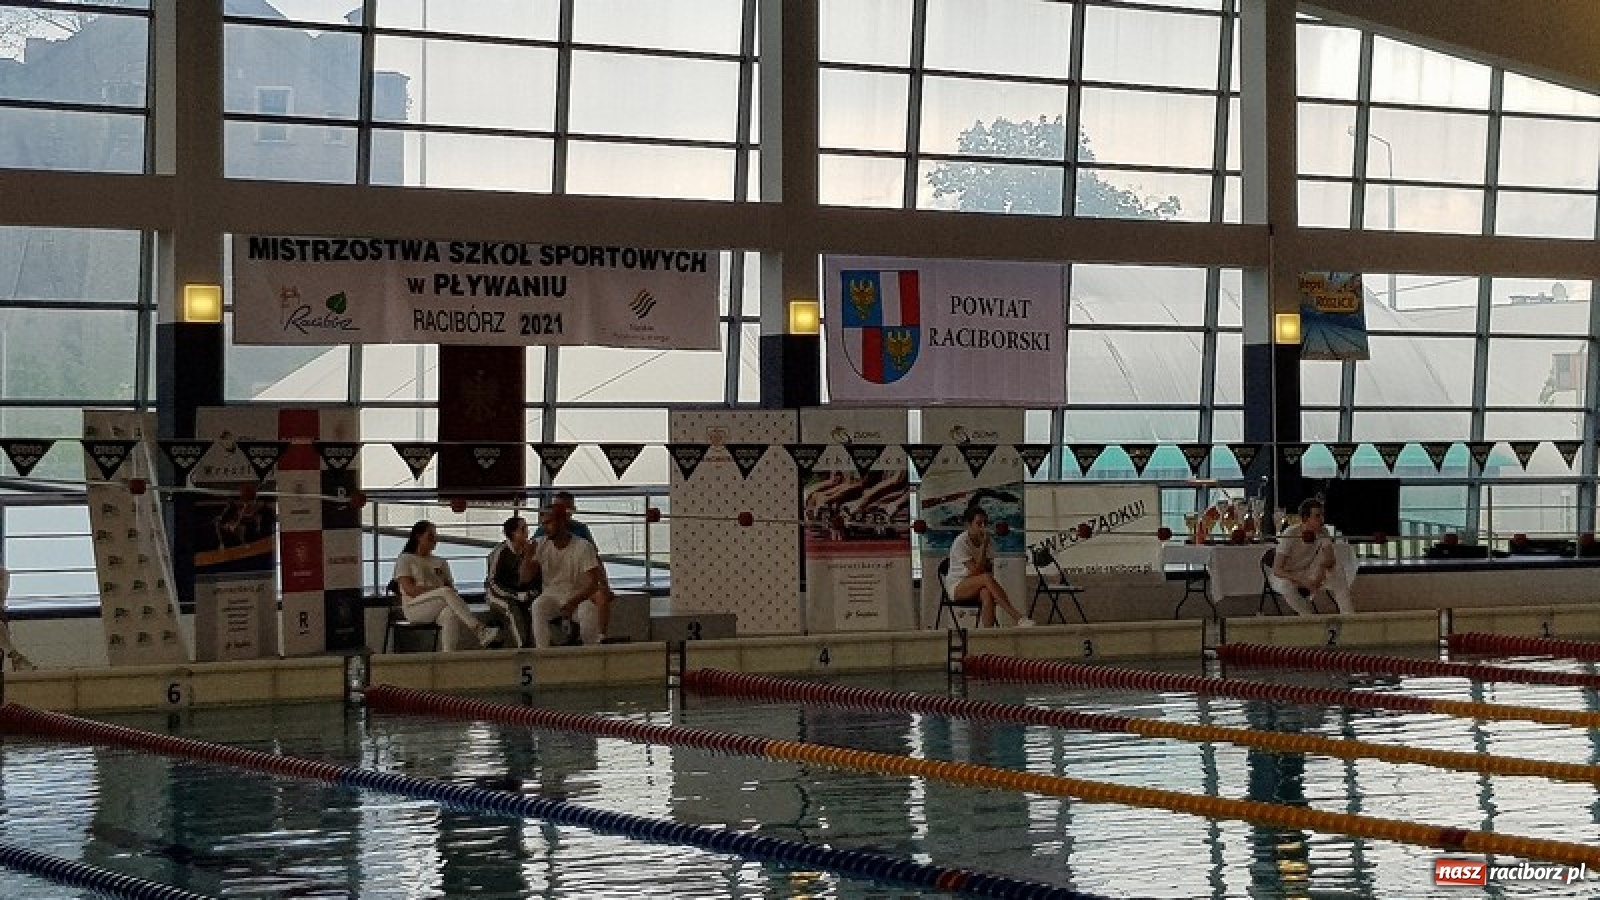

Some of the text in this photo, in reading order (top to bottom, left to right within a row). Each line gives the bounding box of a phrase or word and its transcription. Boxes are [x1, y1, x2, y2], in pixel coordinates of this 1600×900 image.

[249, 237, 440, 262] MISTRZOSTWA
[540, 245, 706, 272] SPORTOWYCH
[407, 274, 567, 297] w PŁYWANIU
[950, 295, 1032, 319] POWIAT
[413, 304, 563, 335] RACIBÓRZ 2021
[929, 328, 1051, 351] RACIBORSKI
[1327, 628, 1337, 645] 2
[818, 646, 831, 665] 4
[1083, 639, 1093, 657] 3
[520, 666, 533, 686] 5
[167, 683, 181, 703] 6
